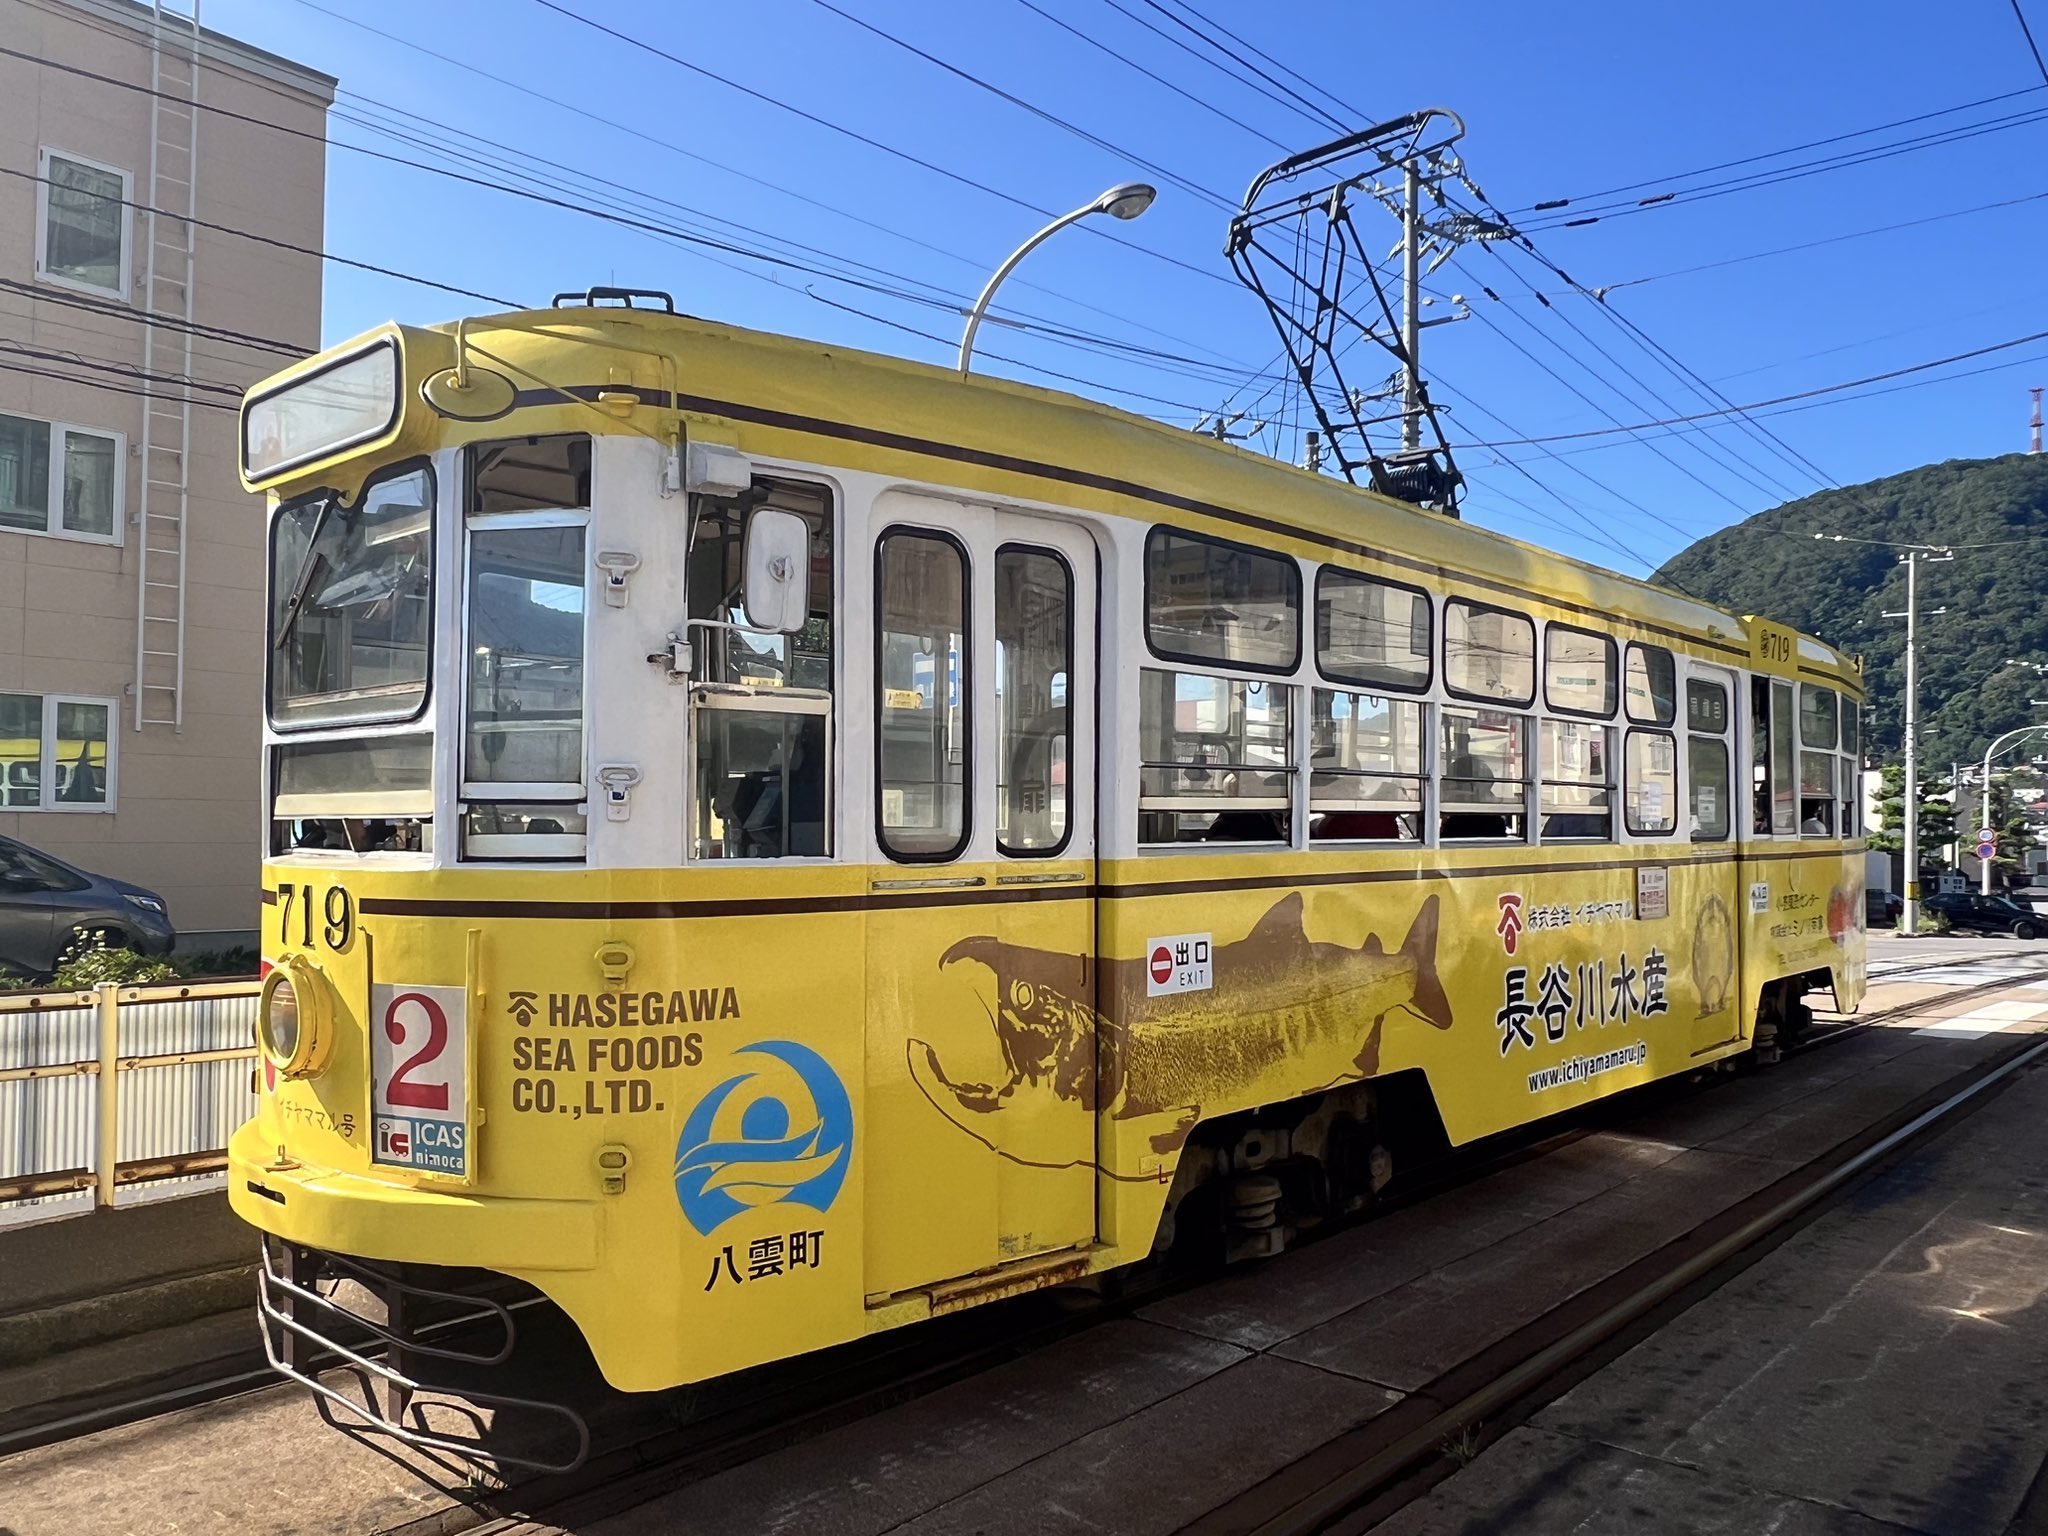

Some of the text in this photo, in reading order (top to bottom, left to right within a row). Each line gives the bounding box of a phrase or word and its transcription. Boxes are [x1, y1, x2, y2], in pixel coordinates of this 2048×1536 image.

[1770, 632, 1790, 663] 719
[278, 883, 355, 955] 719
[1175, 941, 1209, 967] 出口
[1179, 969, 1205, 987] EXIT
[548, 986, 741, 1029] HASEGAWA
[1496, 946, 1669, 1055] 長谷川水産
[384, 992, 450, 1111] 2
[512, 1032, 704, 1073] SEA FOODS
[1527, 1040, 1647, 1093] www.ichiyamamaru.jp
[511, 1077, 665, 1121] CO.,LTD.
[415, 1120, 464, 1150] ICAS
[415, 1149, 465, 1170] nimoca
[703, 1229, 825, 1293] 八雲町
